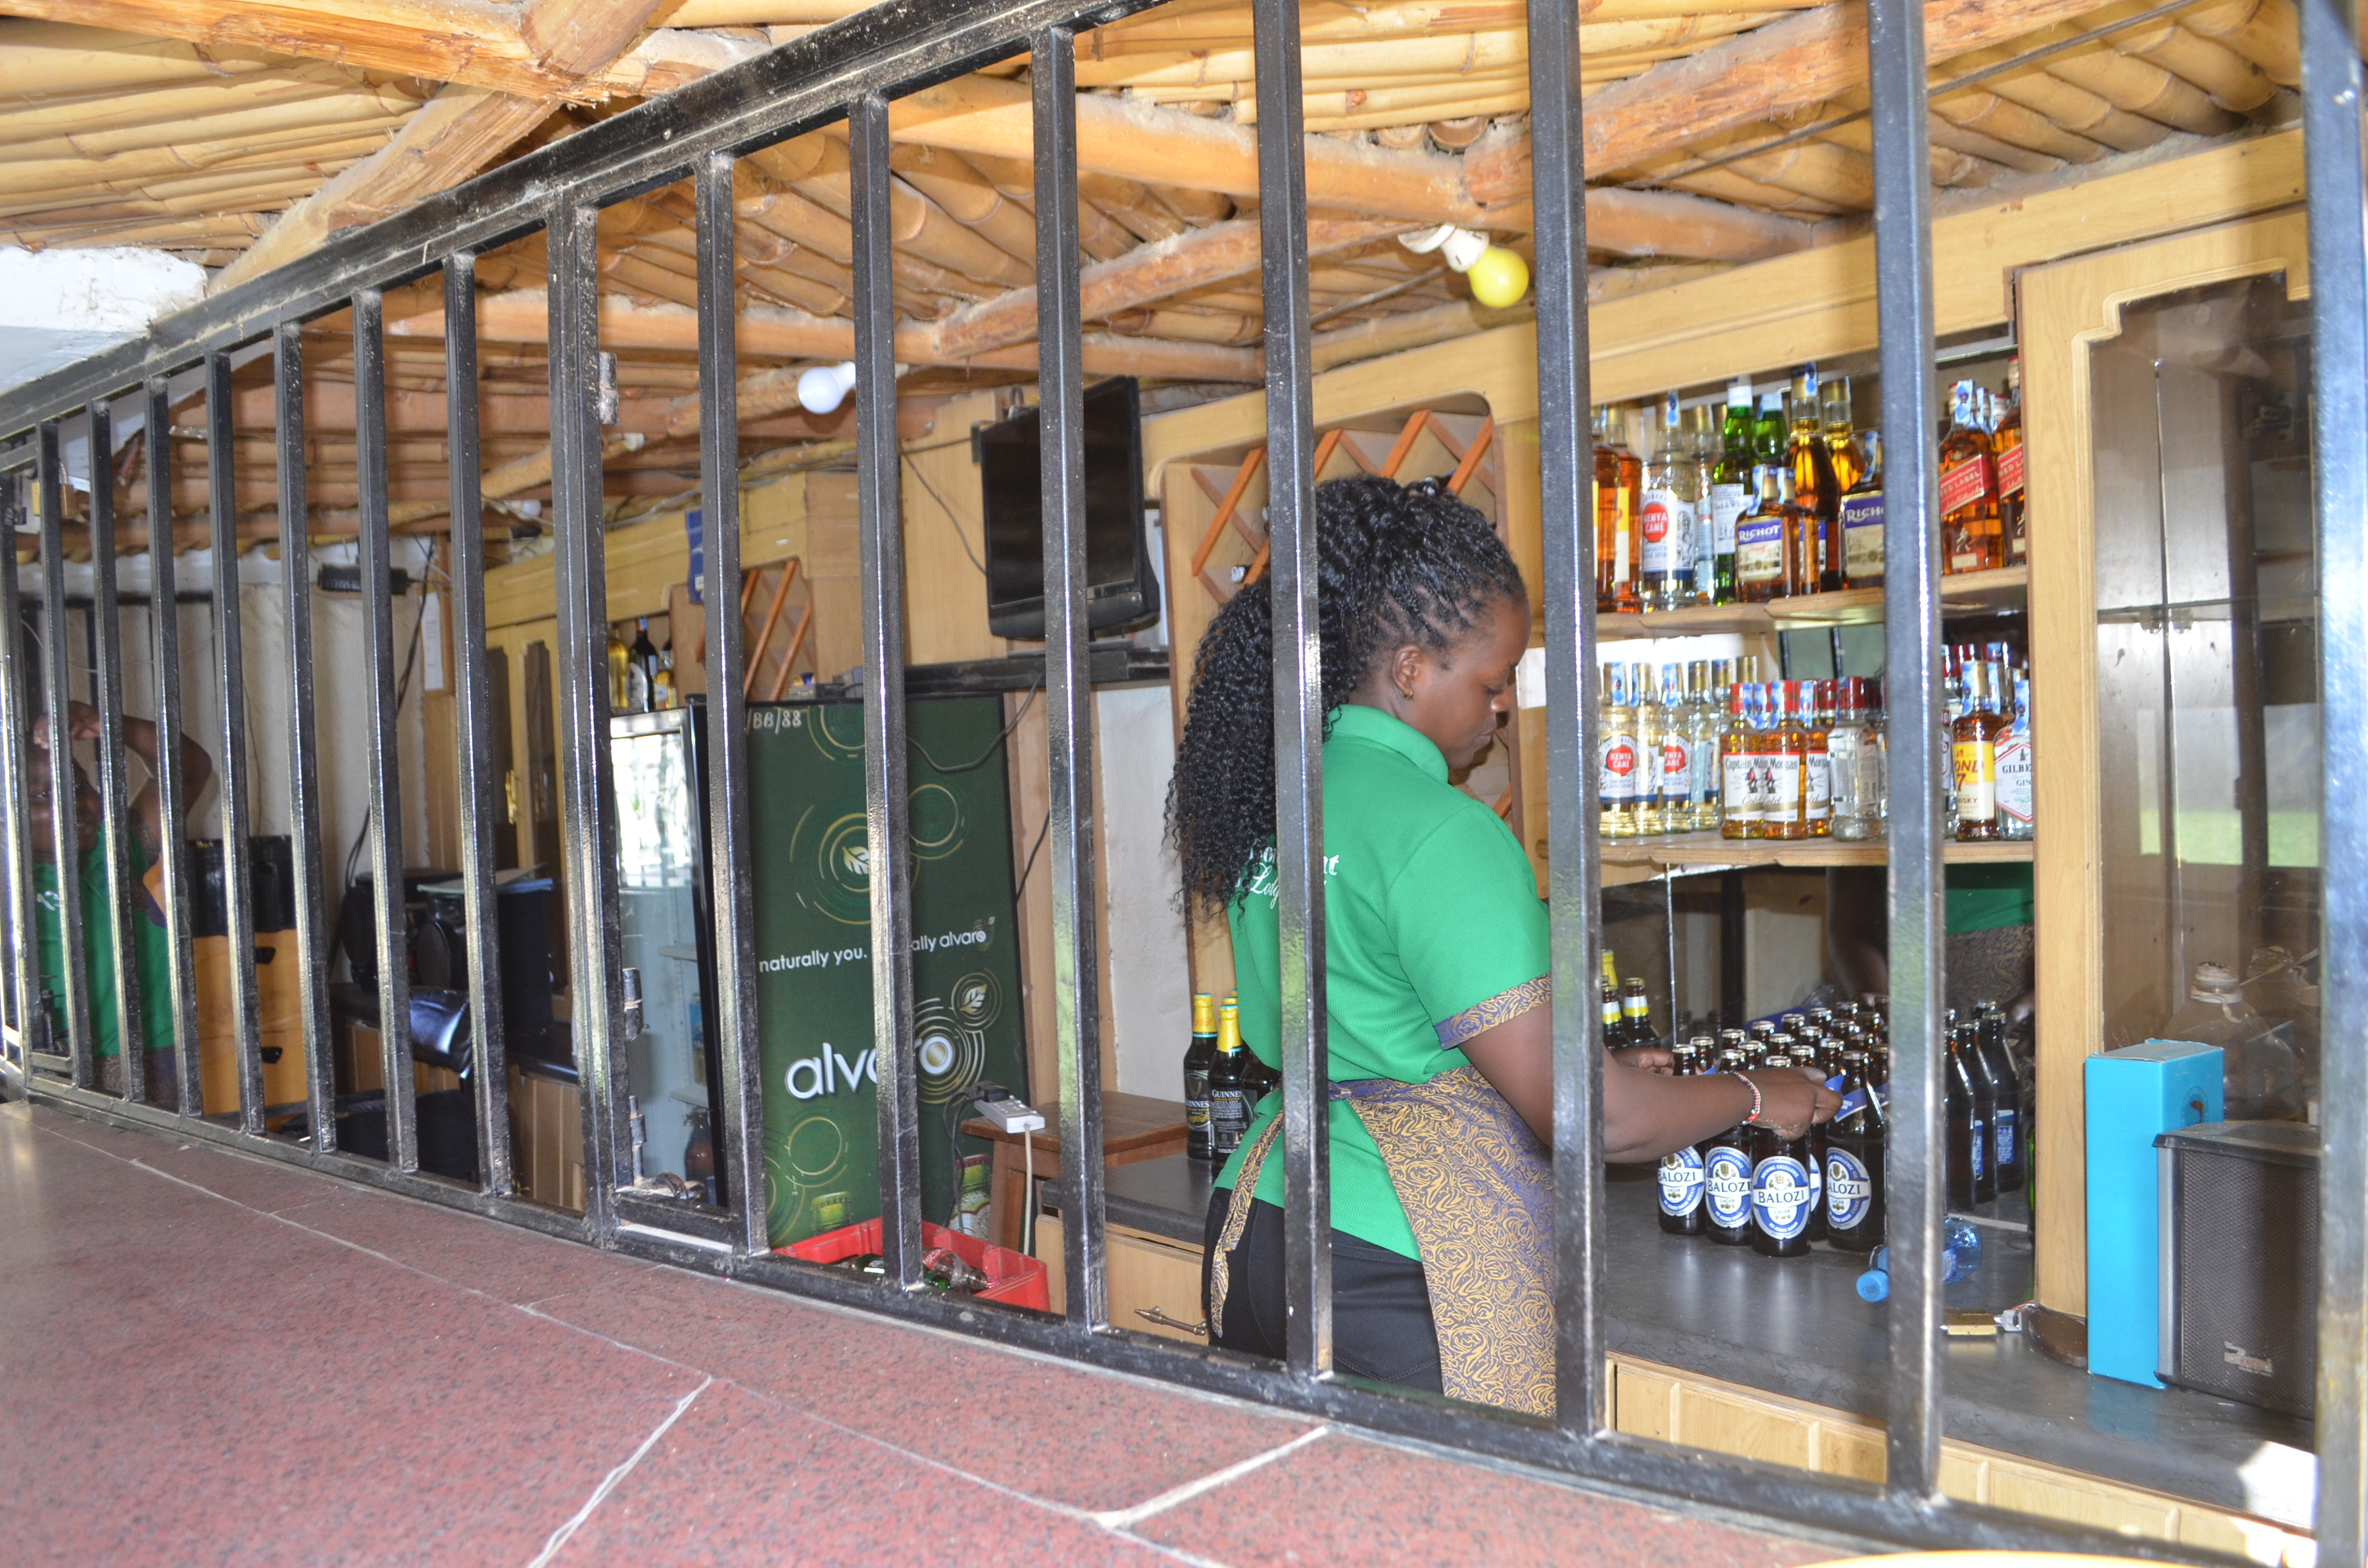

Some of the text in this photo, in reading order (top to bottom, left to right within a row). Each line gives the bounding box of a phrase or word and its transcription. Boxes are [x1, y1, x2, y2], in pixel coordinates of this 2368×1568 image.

[1955, 471, 1980, 488] LABEL
[1645, 523, 1665, 533] CANE
[1738, 525, 1781, 541] RICHOT
[1610, 752, 1632, 760] KENYA
[1612, 760, 1631, 769] CANE
[1725, 758, 1752, 771] Captain
[1955, 760, 1984, 773] OND
[2002, 765, 2032, 774] GILBE
[759, 949, 830, 973] naturally
[832, 947, 867, 965] you.
[939, 931, 987, 948] alvaro
[785, 1035, 953, 1099] alvo
[1658, 1170, 1696, 1183] BALOZI
[1708, 1179, 1752, 1193] BALOZI
[1829, 1184, 1861, 1195] ALOZI
[1758, 1189, 1805, 1204] BALOZI
